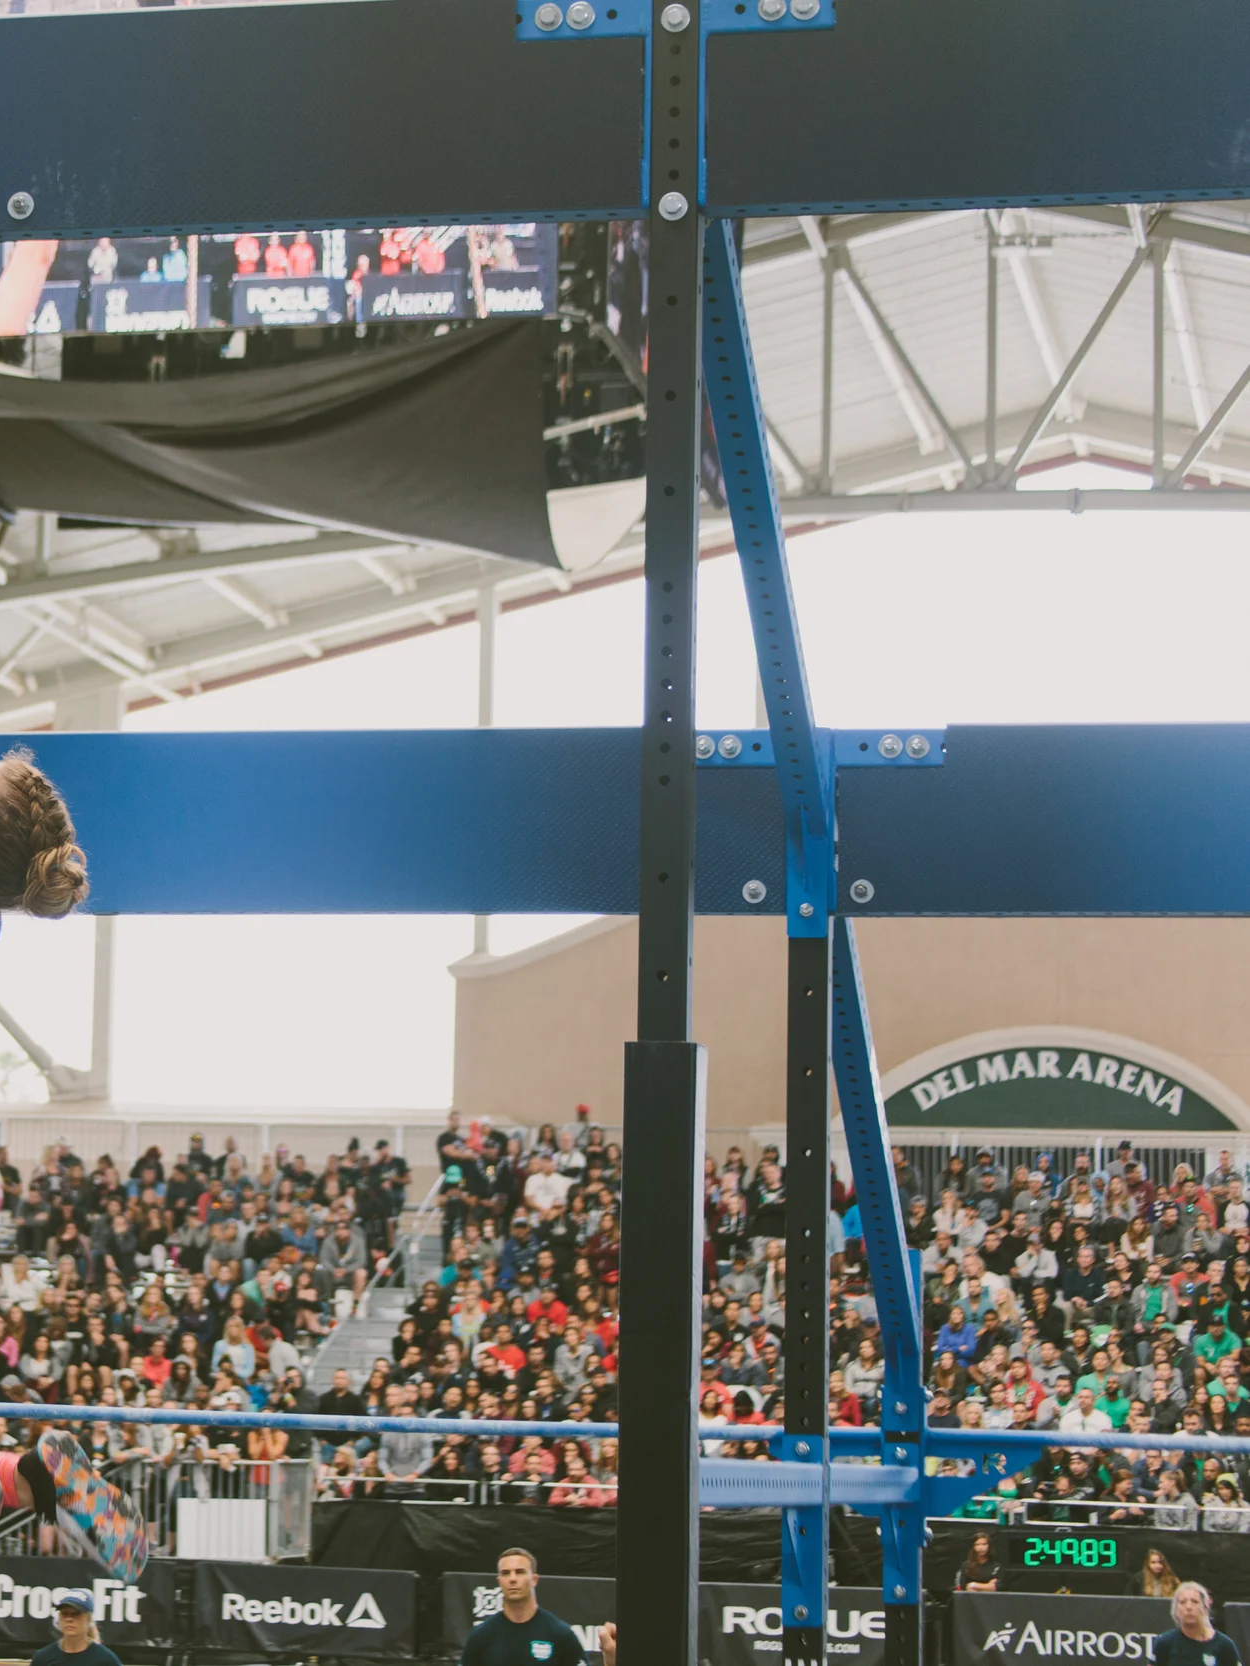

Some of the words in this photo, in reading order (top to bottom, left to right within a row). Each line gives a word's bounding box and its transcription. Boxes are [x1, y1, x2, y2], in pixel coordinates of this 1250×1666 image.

[910, 1069, 976, 1111] DEL
[977, 1050, 1060, 1086] MAR
[1066, 1052, 1185, 1117] ARENA
[222, 1593, 344, 1626] Reebok
[722, 1606, 886, 1639] ROUE
[1015, 1620, 1158, 1661] AIRROST
